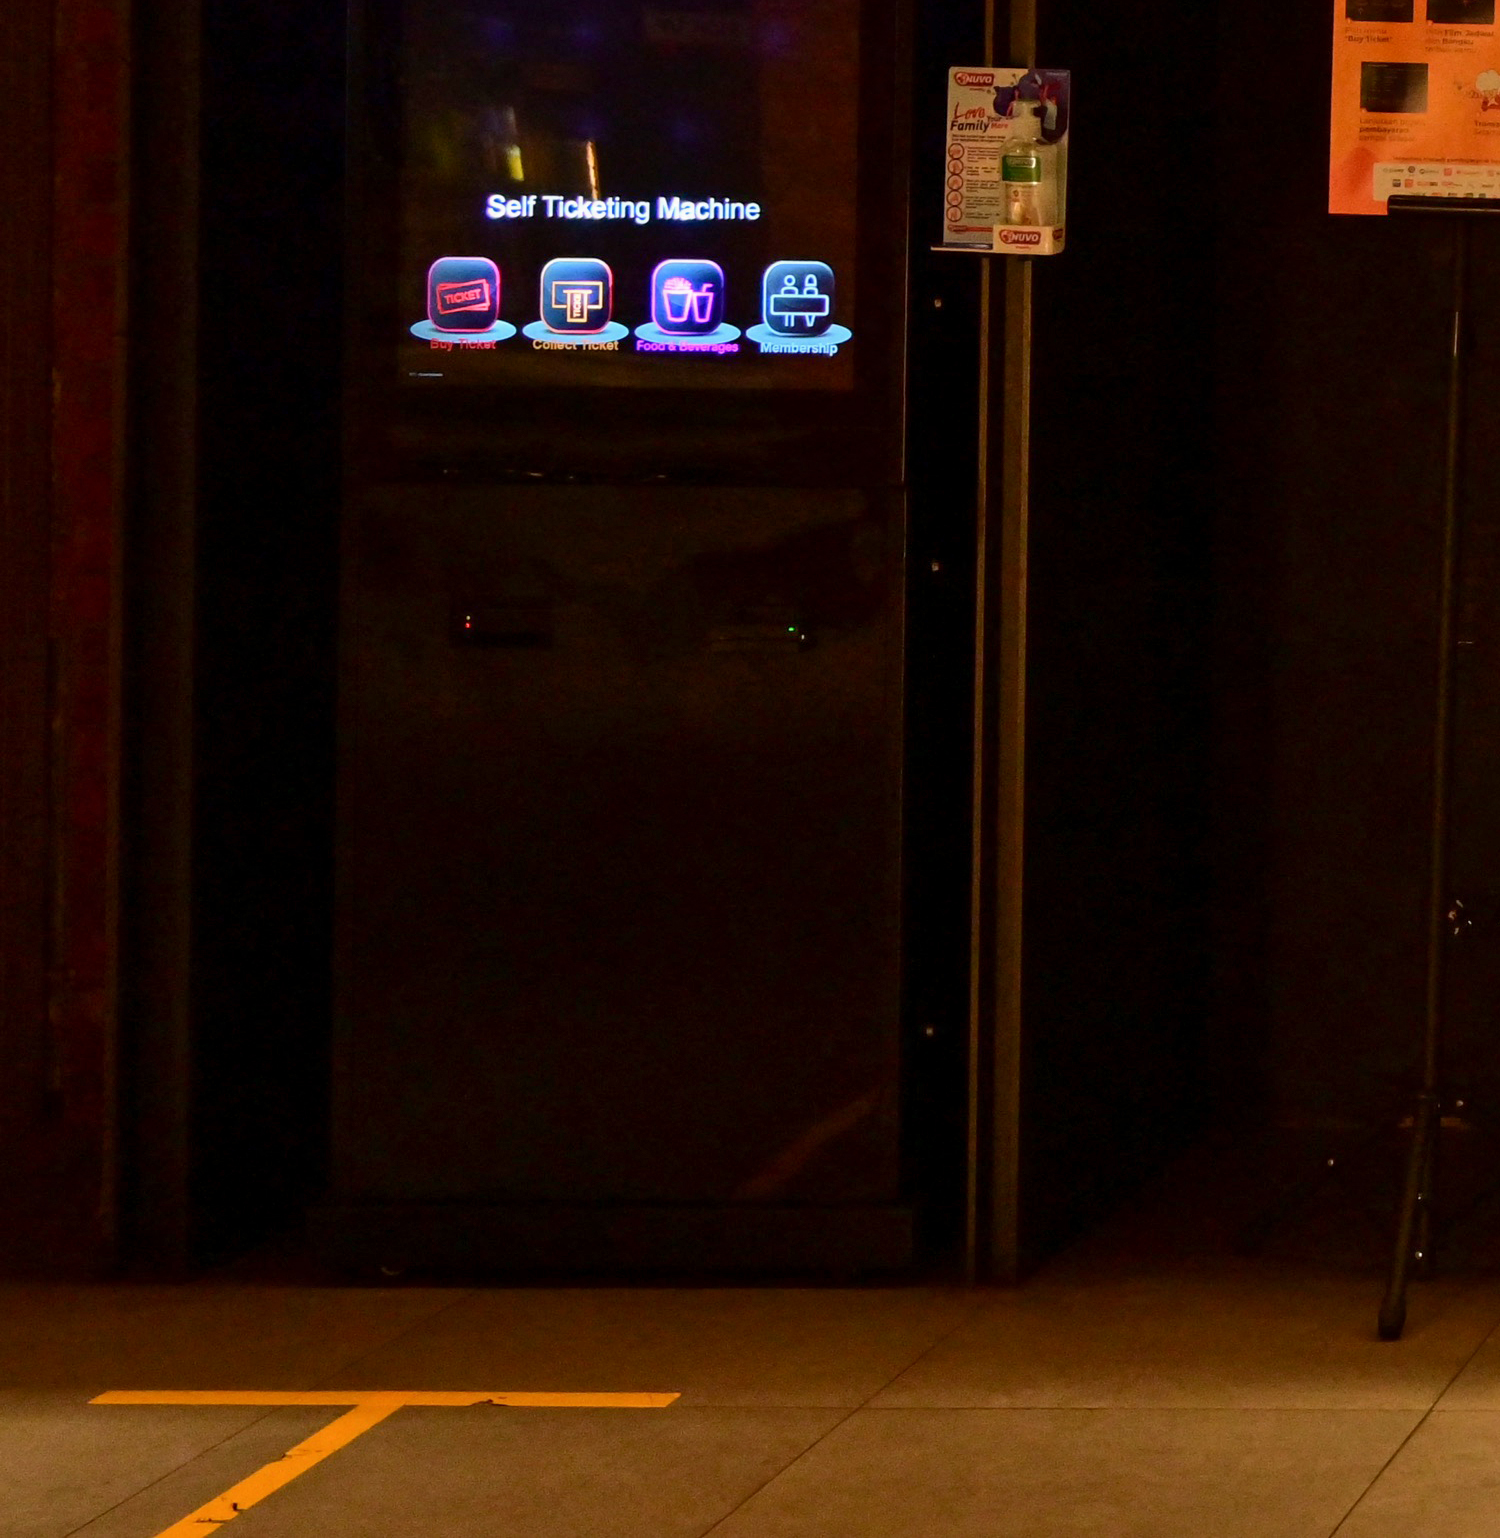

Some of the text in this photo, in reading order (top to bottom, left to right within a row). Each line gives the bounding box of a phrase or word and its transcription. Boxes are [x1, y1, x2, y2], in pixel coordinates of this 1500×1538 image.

[954, 101, 986, 120] Love
[950, 119, 990, 133] Family
[487, 194, 761, 225] Self Ticketing Machine
[1011, 232, 1040, 243] NUVO
[443, 288, 482, 305] TICKET
[430, 338, 453, 352] Buy
[532, 339, 619, 352] Collect Ticket
[636, 339, 740, 355] Food & Beverages
[759, 342, 839, 357] Membership
